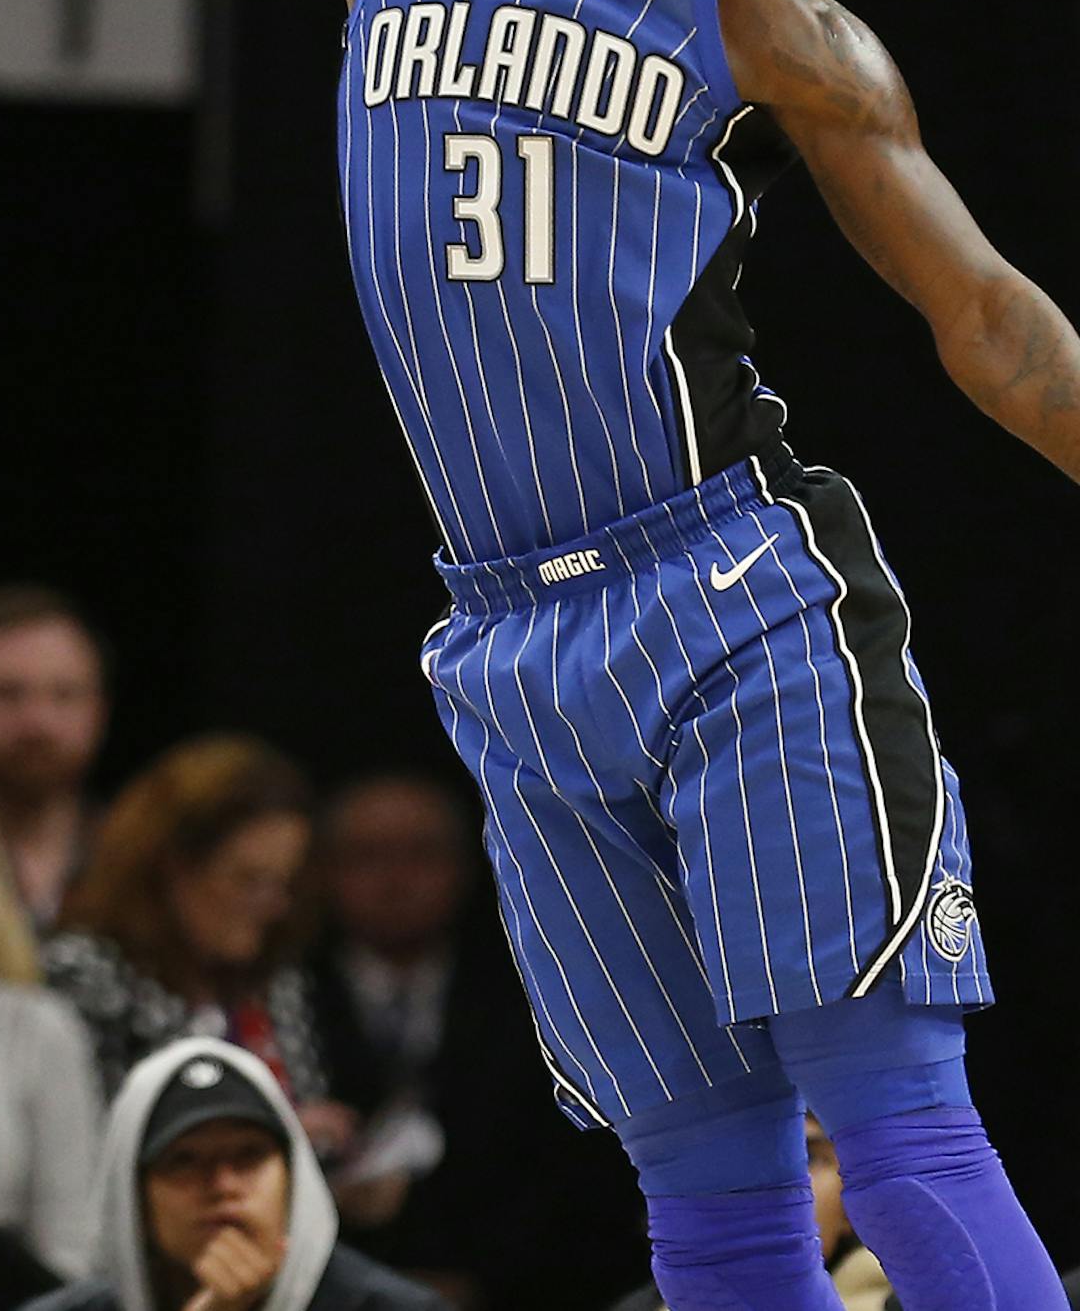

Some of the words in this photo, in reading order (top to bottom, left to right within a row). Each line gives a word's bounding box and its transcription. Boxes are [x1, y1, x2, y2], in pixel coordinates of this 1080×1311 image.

[363, 0, 685, 157] ORLANDO
[443, 133, 557, 284] 31
[537, 549, 607, 586] MAGIC
